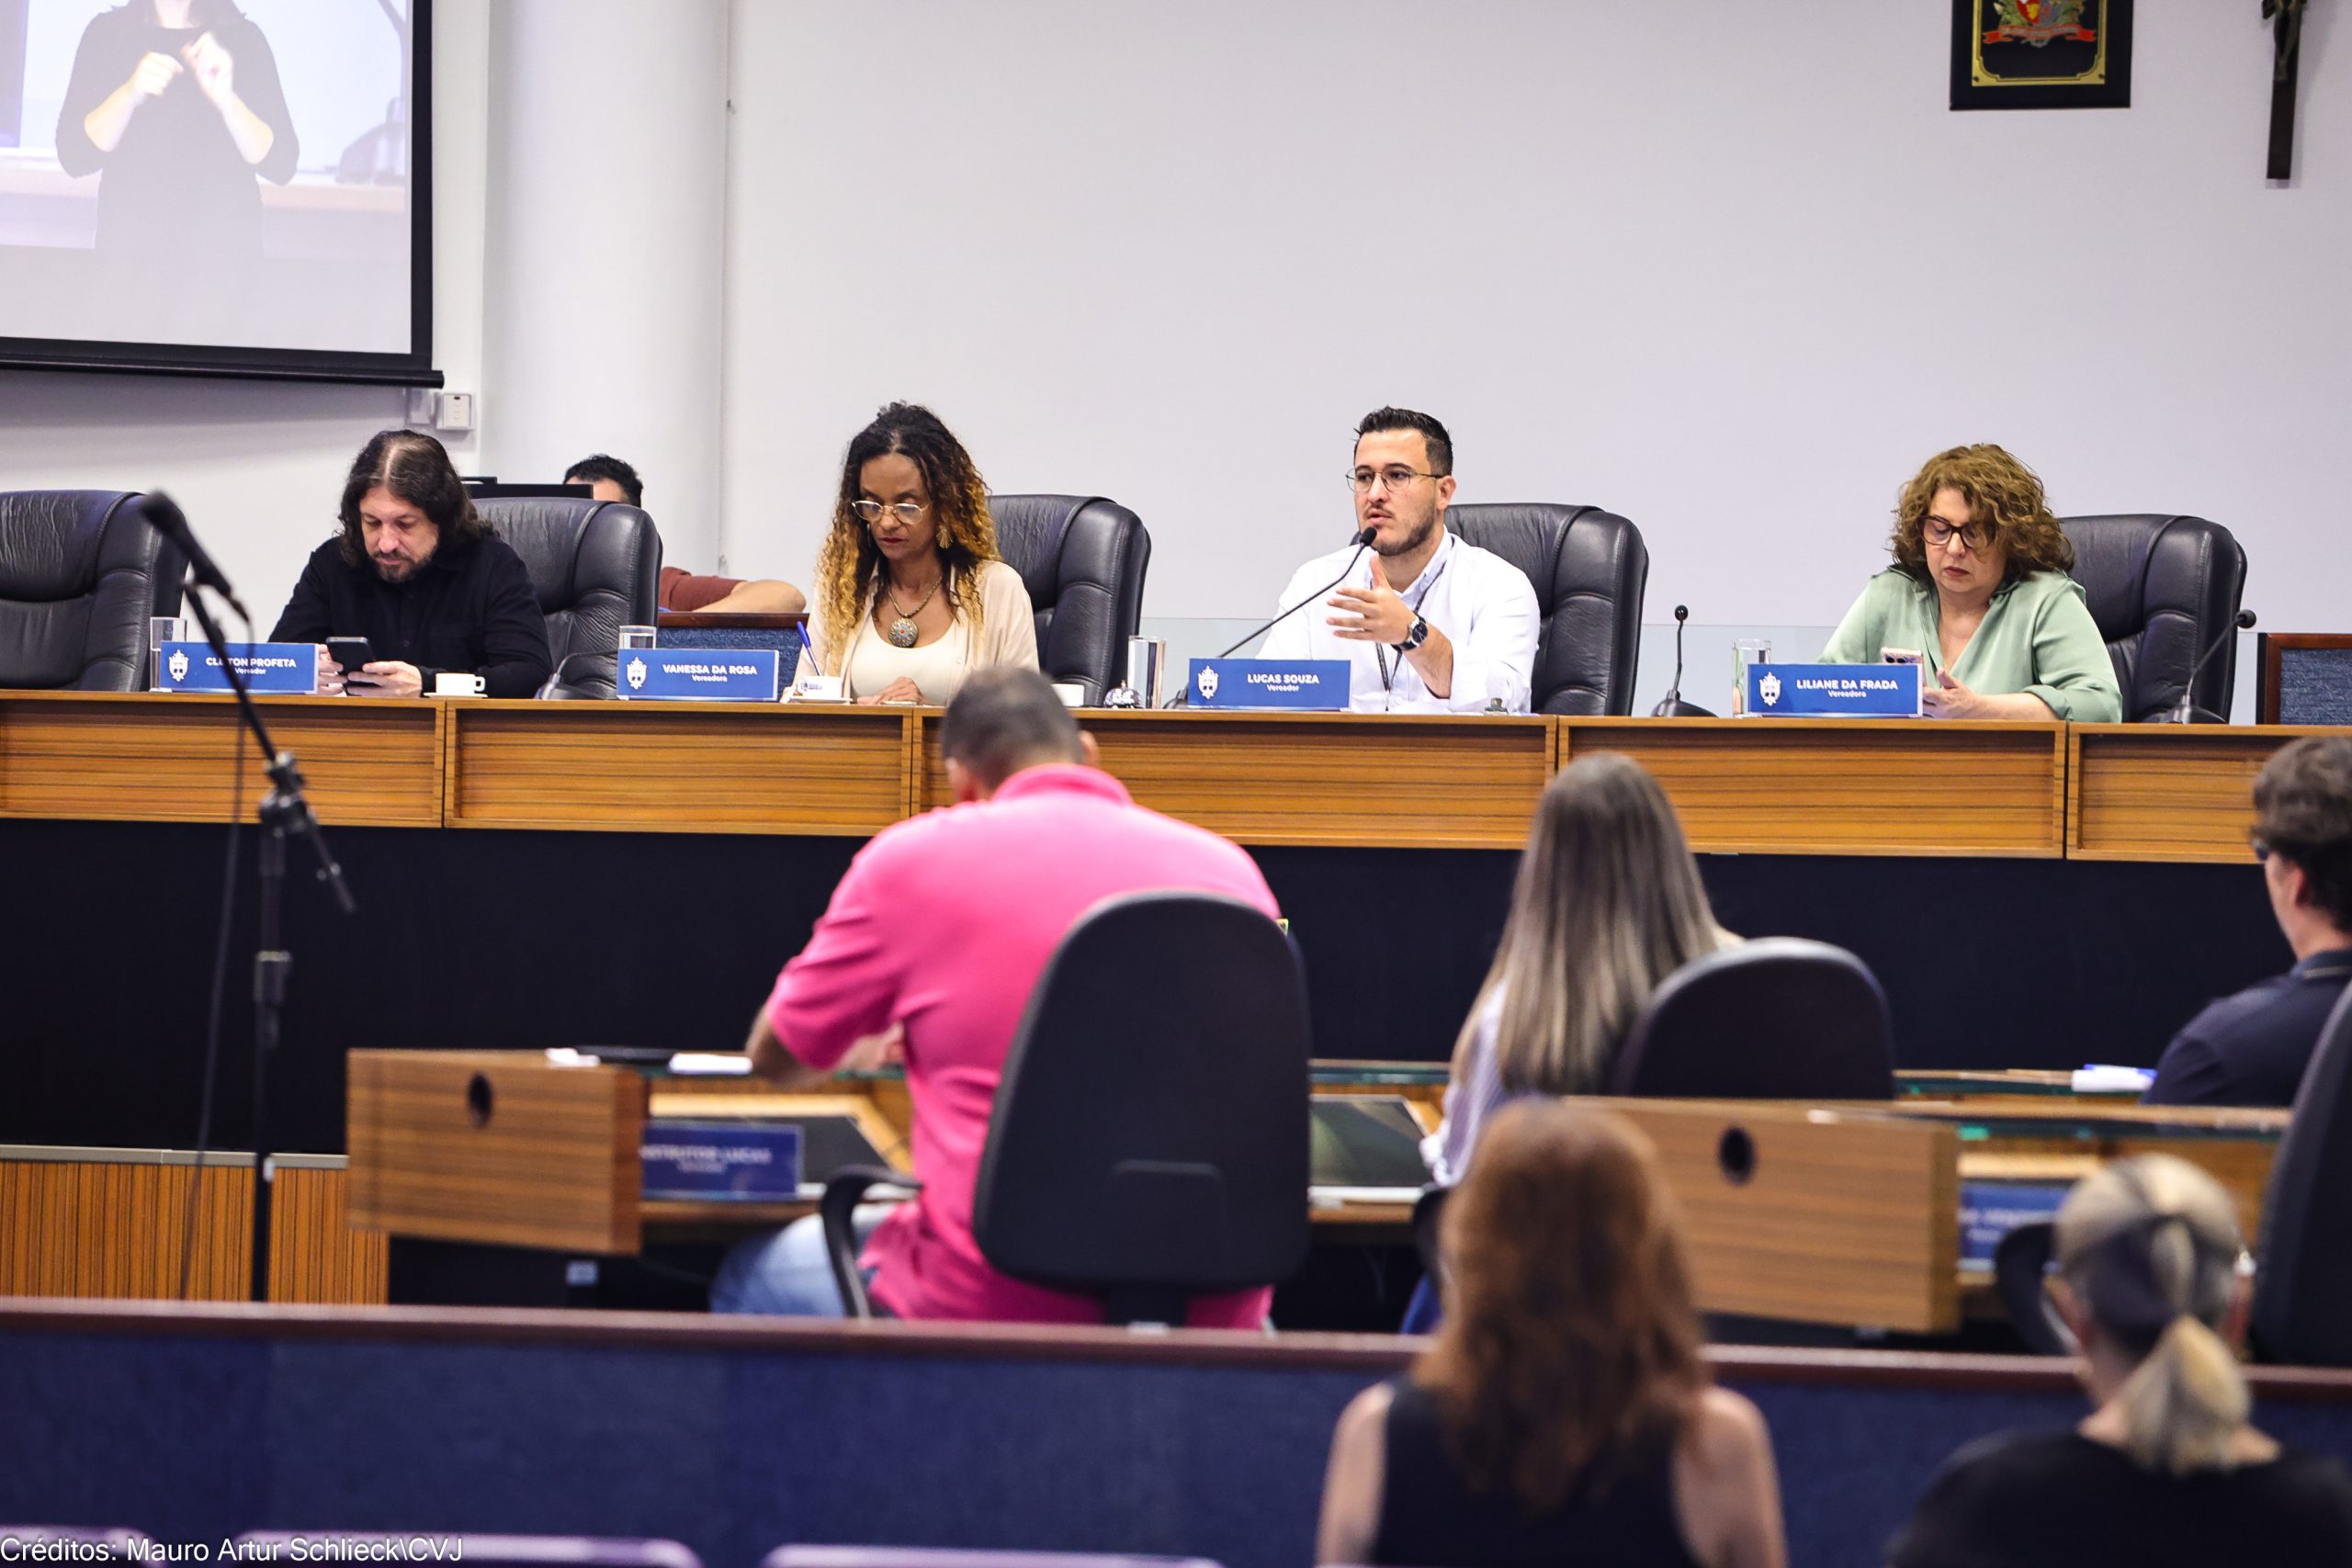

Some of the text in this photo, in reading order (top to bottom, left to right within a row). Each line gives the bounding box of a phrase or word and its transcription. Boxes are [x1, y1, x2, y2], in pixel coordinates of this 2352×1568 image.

[250, 658, 297, 668] PROFETA
[662, 664, 757, 675] VANESSA DA ROSA
[692, 674, 728, 682] Vereadora
[1247, 673, 1319, 684] LUCAS SOUZA
[1267, 683, 1299, 692] Vereador
[1796, 680, 1899, 690] LILIANE DA FRADA
[1828, 690, 1867, 698] Vereadora
